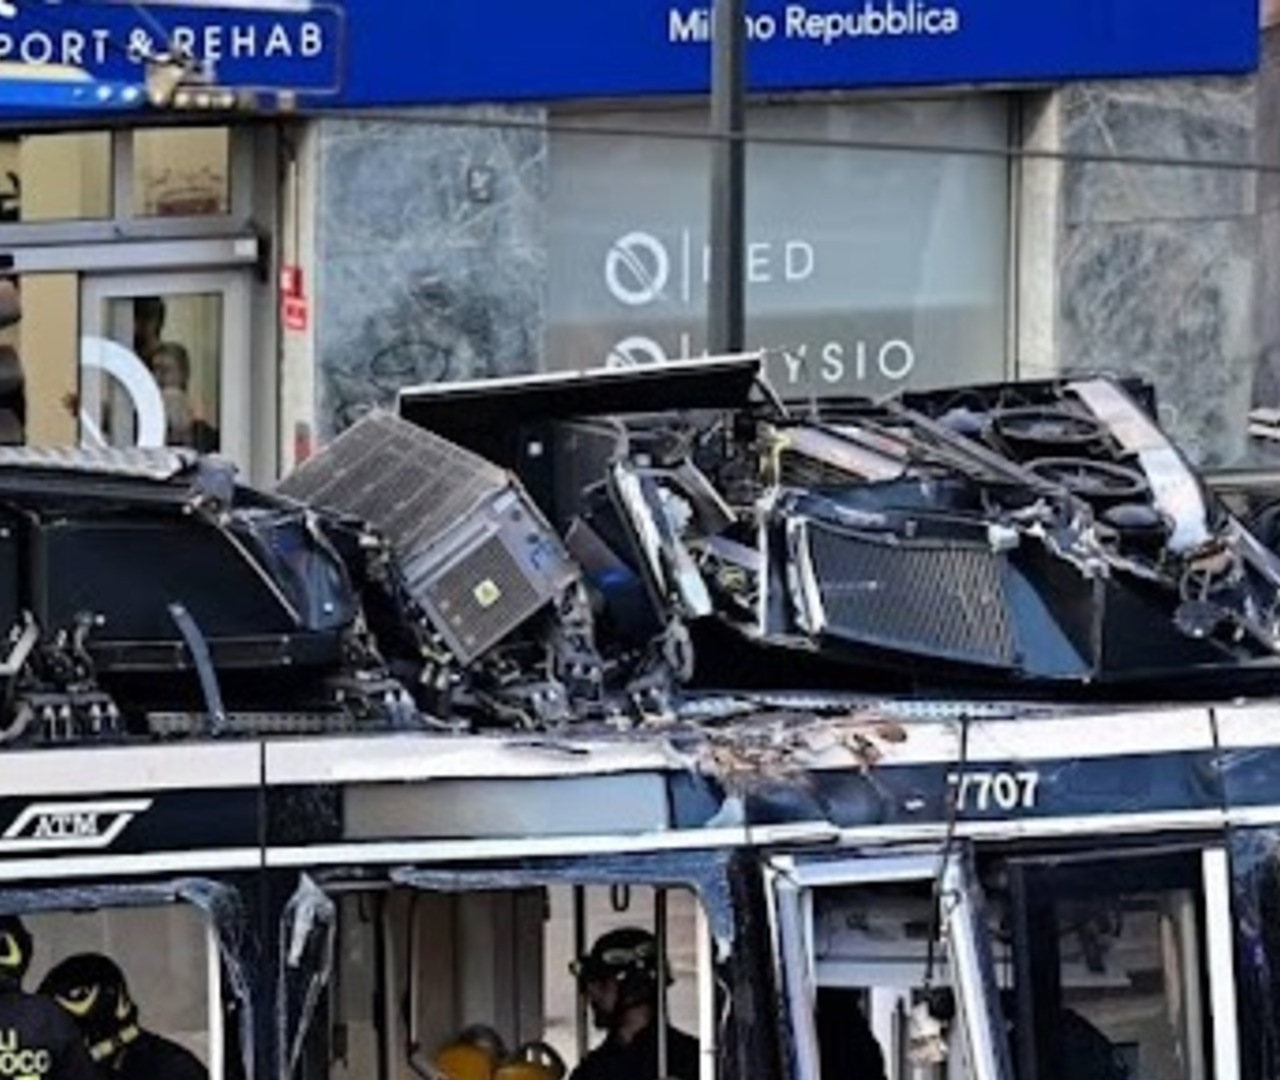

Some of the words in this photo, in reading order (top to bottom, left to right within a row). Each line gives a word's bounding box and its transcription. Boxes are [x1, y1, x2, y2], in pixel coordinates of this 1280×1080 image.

[127, 28, 153, 62] &
[173, 21, 322, 60] REHAB
[785, 0, 959, 45] Repubblica
[946, 771, 1039, 811] 7707
[32, 813, 100, 838] ATM
